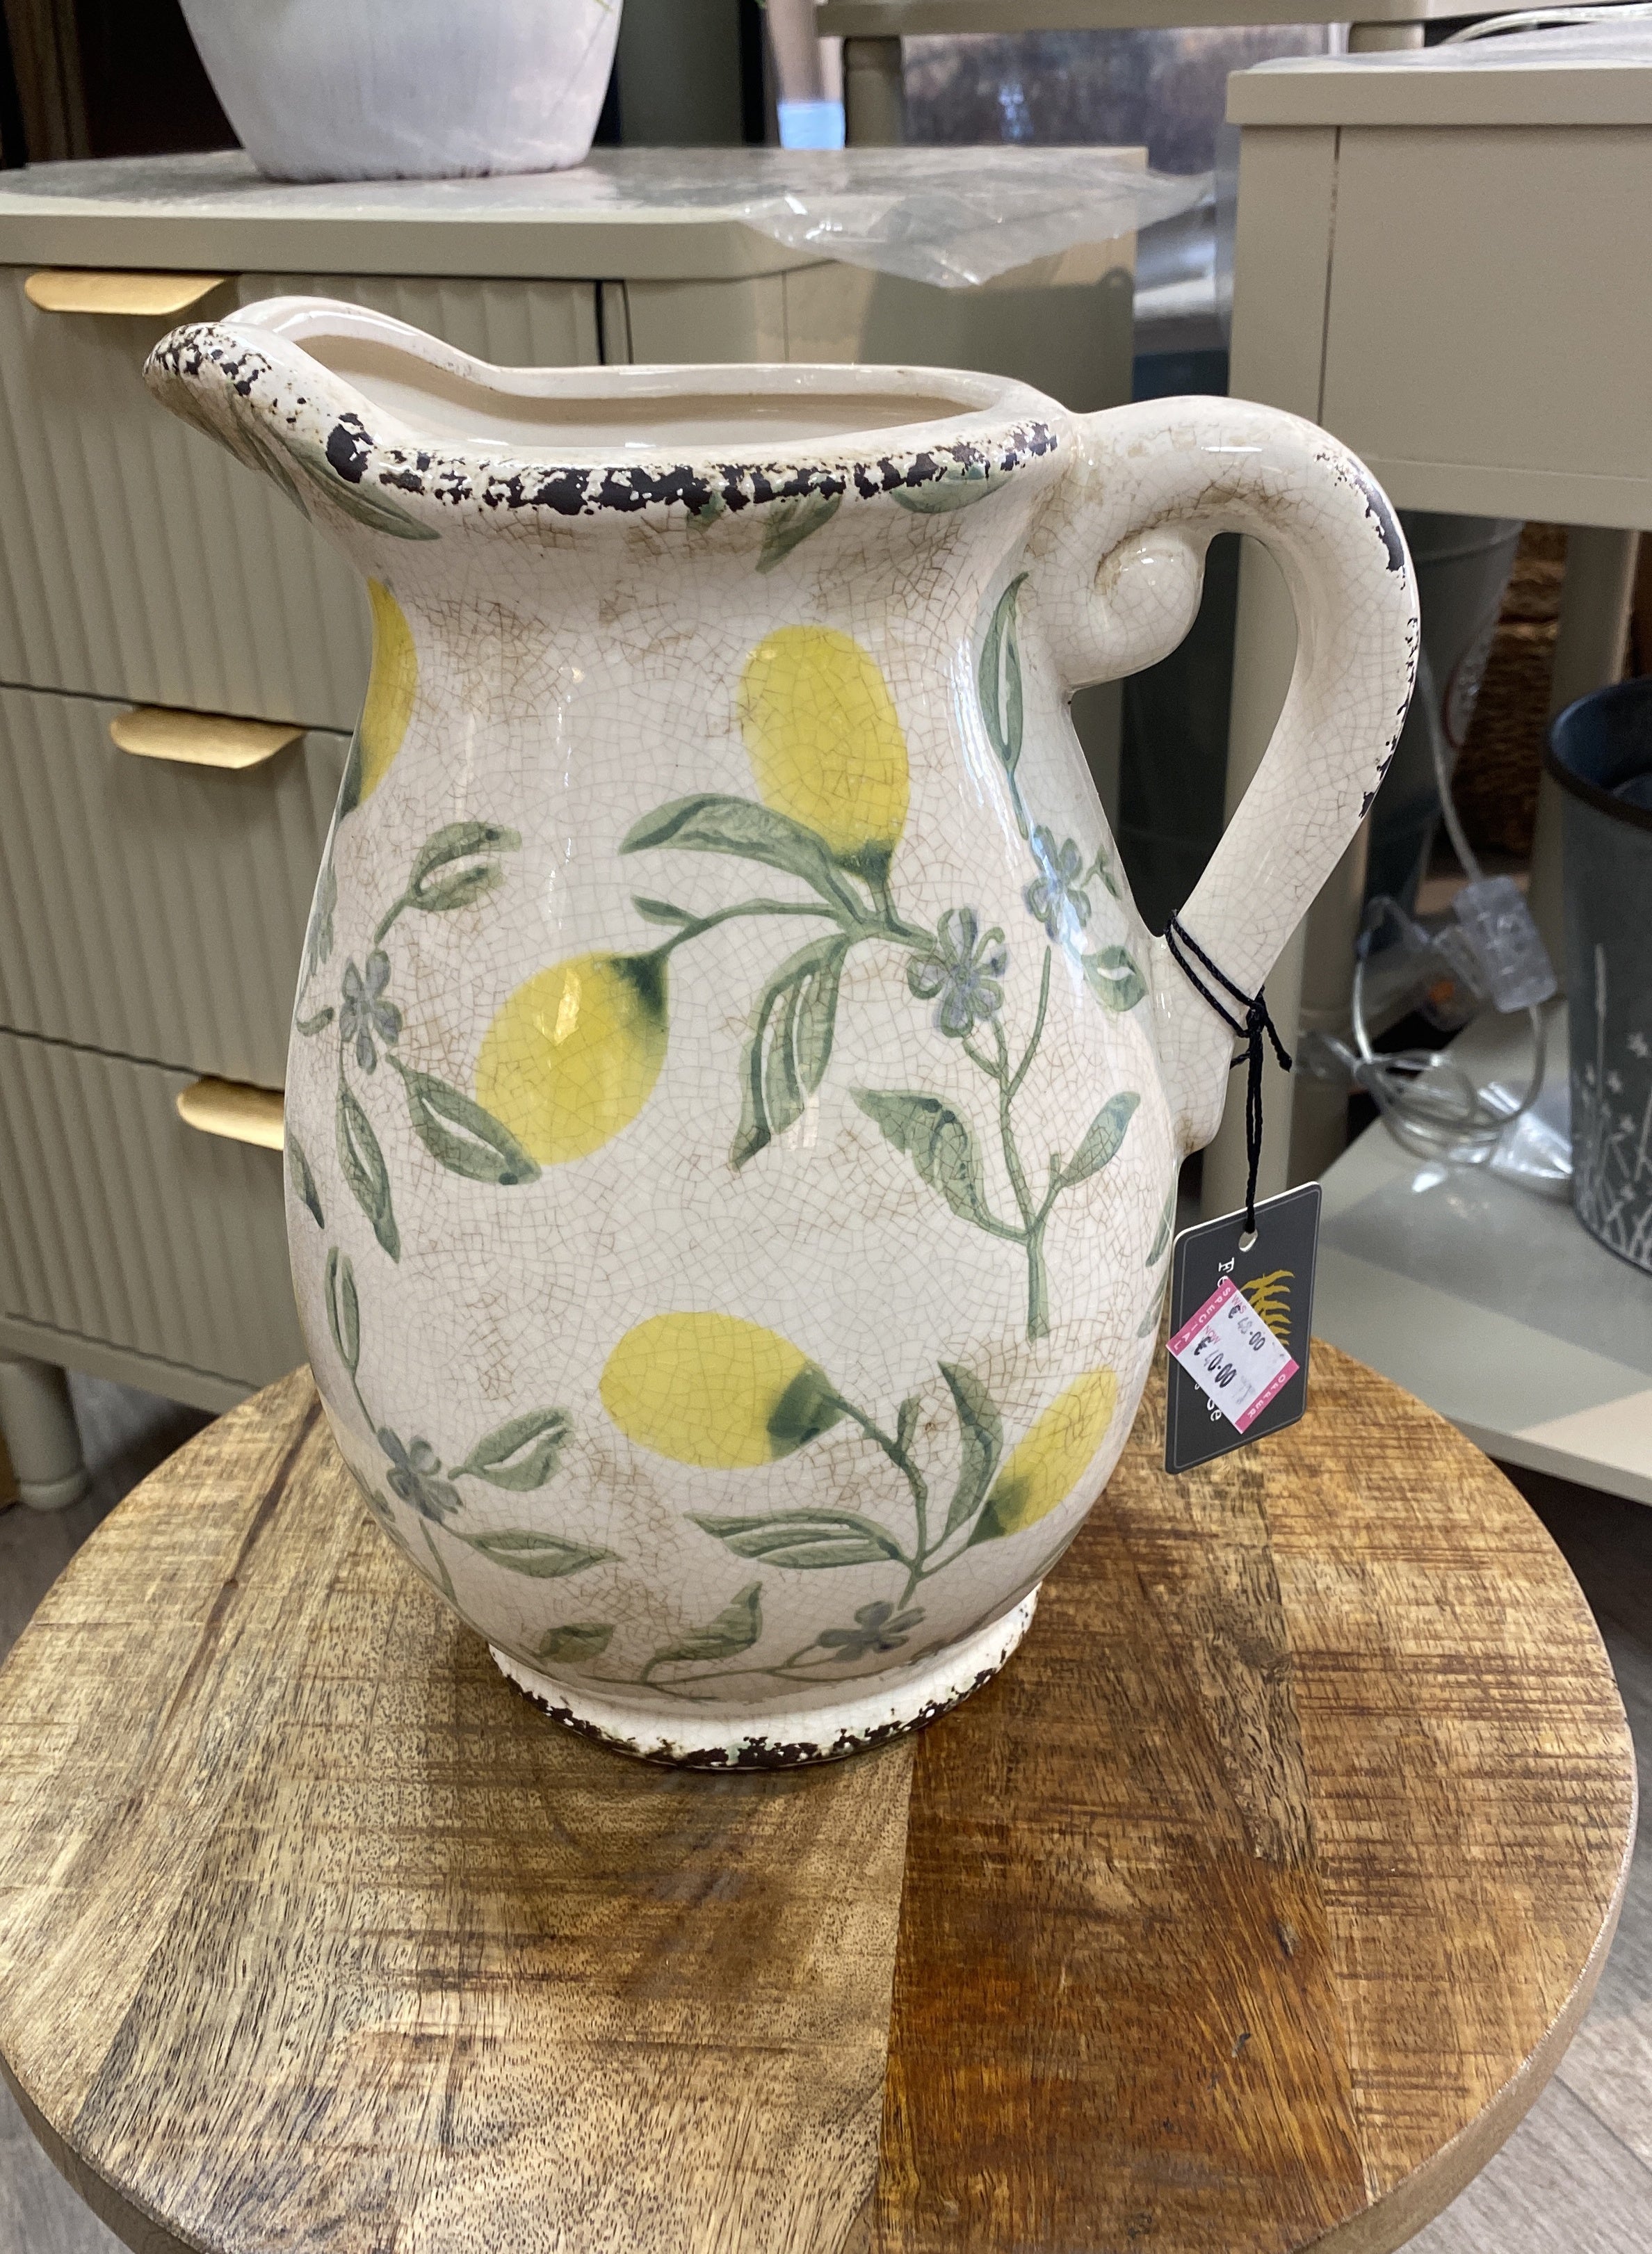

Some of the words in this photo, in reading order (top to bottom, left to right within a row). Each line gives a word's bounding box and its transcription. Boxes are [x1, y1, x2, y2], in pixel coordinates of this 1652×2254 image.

[1173, 1287, 1231, 1351] SPECIAL
[1231, 1295, 1247, 1314] WAS
[1204, 1325, 1222, 1345] NOW
[1247, 1374, 1286, 1419] OFFER
